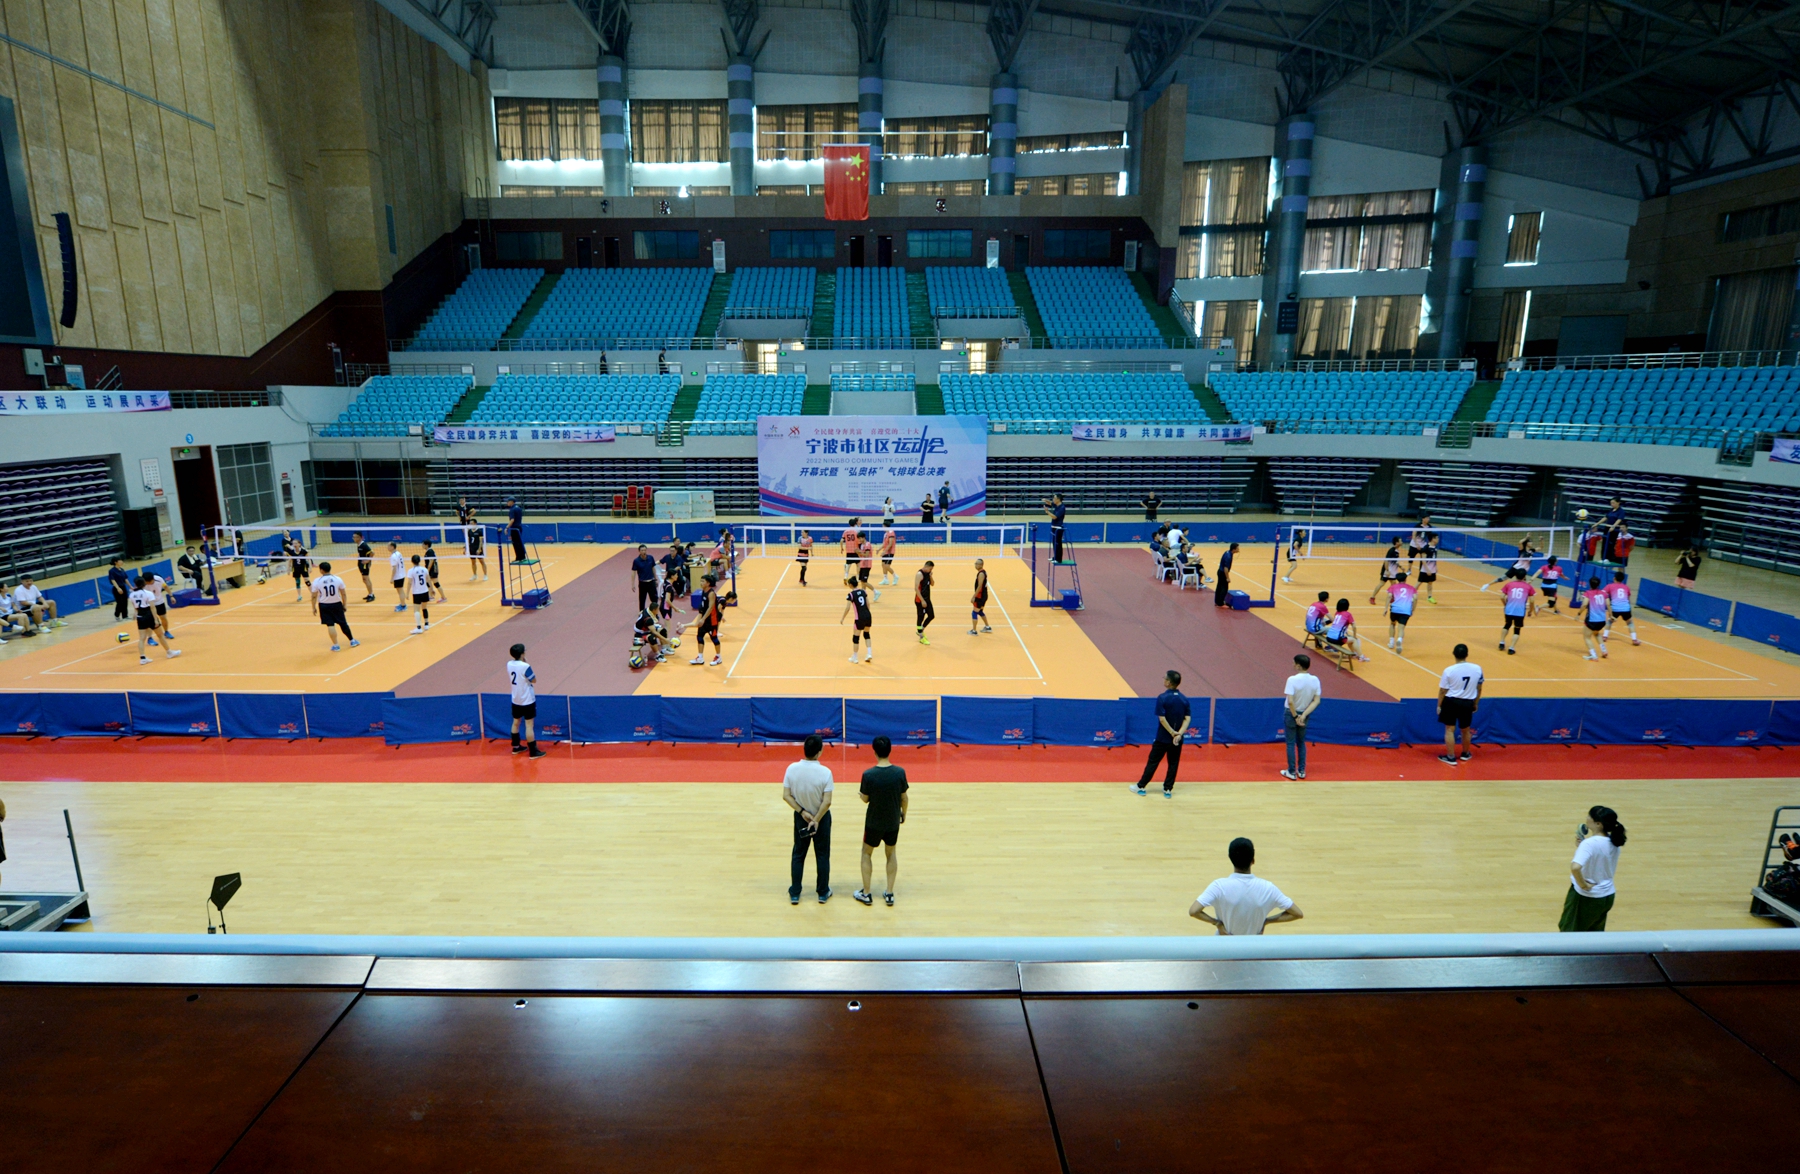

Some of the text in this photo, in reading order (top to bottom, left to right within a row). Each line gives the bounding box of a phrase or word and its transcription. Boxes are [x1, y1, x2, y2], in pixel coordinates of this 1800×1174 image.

[86, 394, 160, 408] 运动展风采
[446, 429, 604, 441] 全民健身奔共富 喜迎党的二十大
[814, 428, 863, 436] 全民健身奔共富
[1084, 428, 1243, 439] 全民健身 共享健康 共同富裕
[846, 534, 856, 542] 50
[418, 574, 425, 586] 5
[323, 584, 336, 598] 10
[1399, 587, 1408, 598] 2
[1511, 587, 1524, 600] 16
[1616, 588, 1625, 599] 6
[857, 595, 865, 607] 9
[1593, 594, 1605, 606] 10
[510, 671, 518, 686] 2
[1462, 676, 1471, 691] 7
